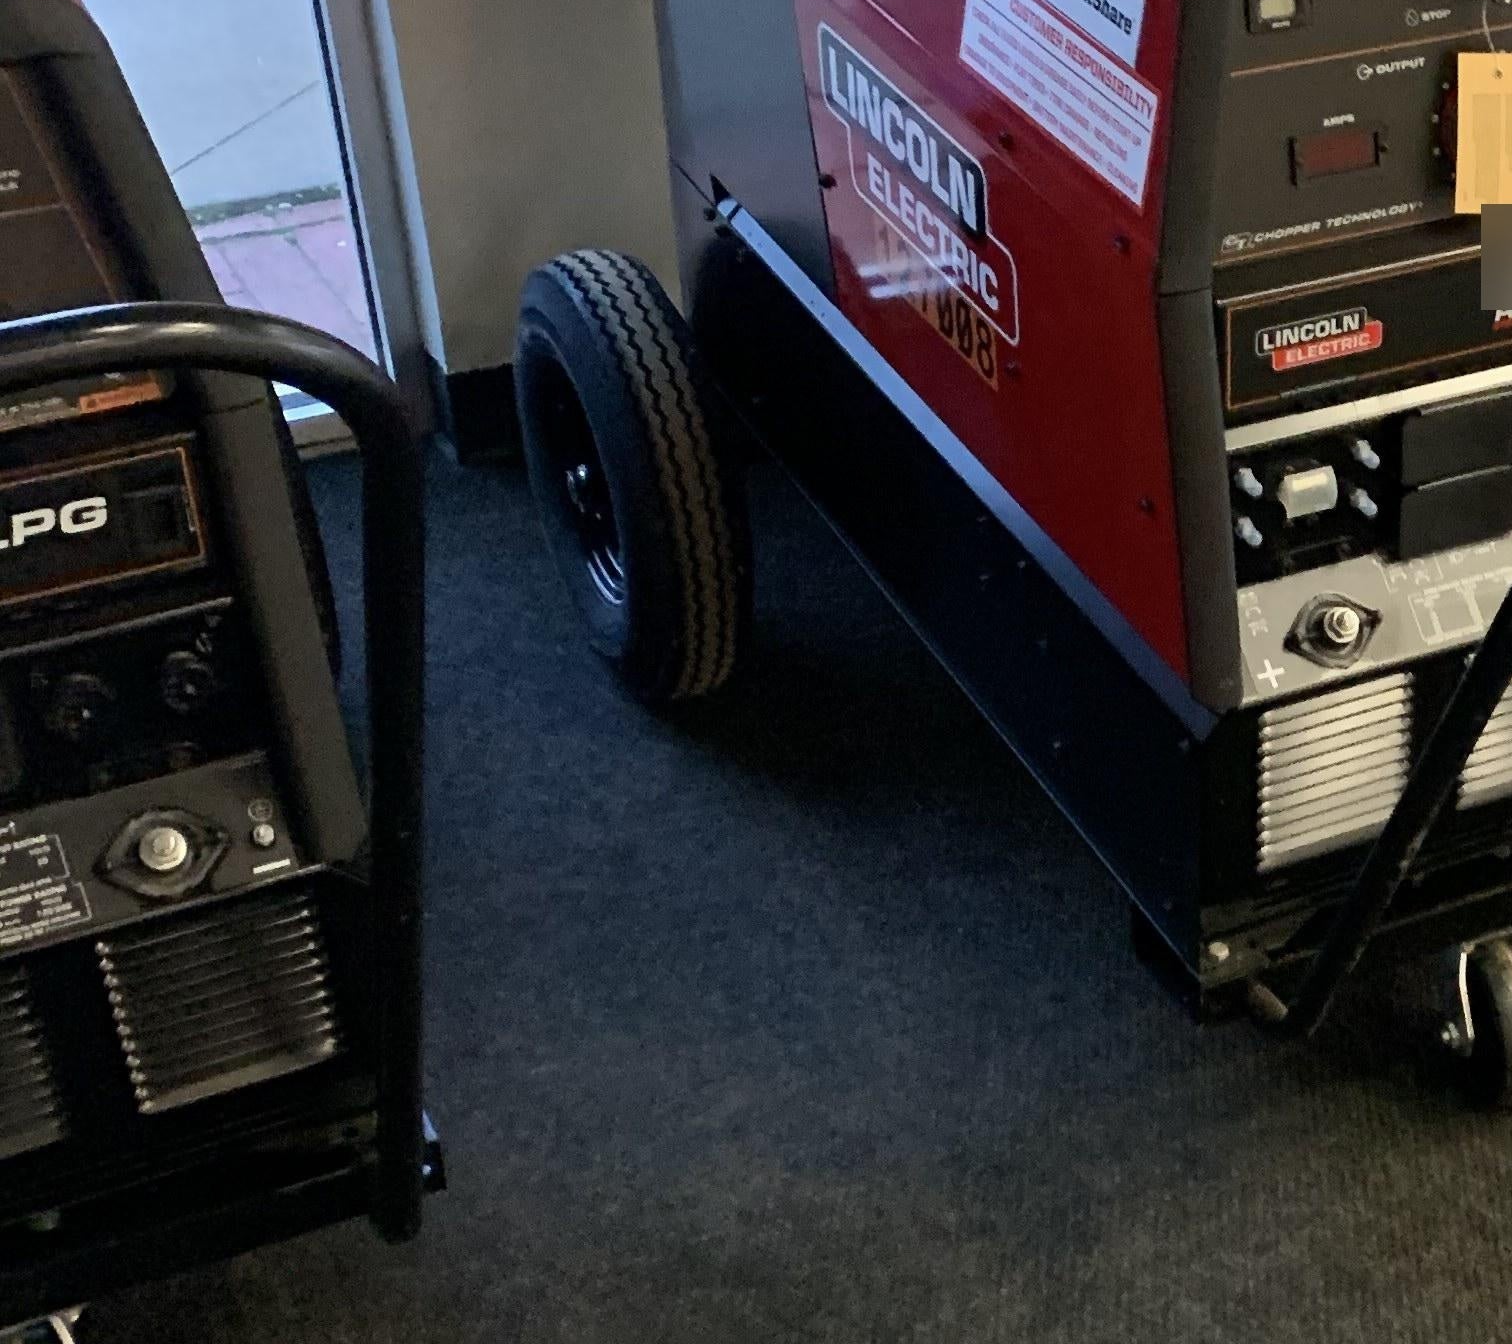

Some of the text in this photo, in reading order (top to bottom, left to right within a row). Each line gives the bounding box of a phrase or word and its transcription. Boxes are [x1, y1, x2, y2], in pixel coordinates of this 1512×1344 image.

[1375, 56, 1427, 75] OUTPUT
[828, 46, 977, 232] LINCOLN
[866, 151, 1000, 312] ELECTRIC
[1254, 221, 1321, 243] CHOPPER
[1326, 201, 1419, 229] TECHNOLOGY
[1261, 312, 1360, 351] LINCOLN
[1285, 331, 1372, 364] ELECTRIC
[0, 496, 108, 550] PG
